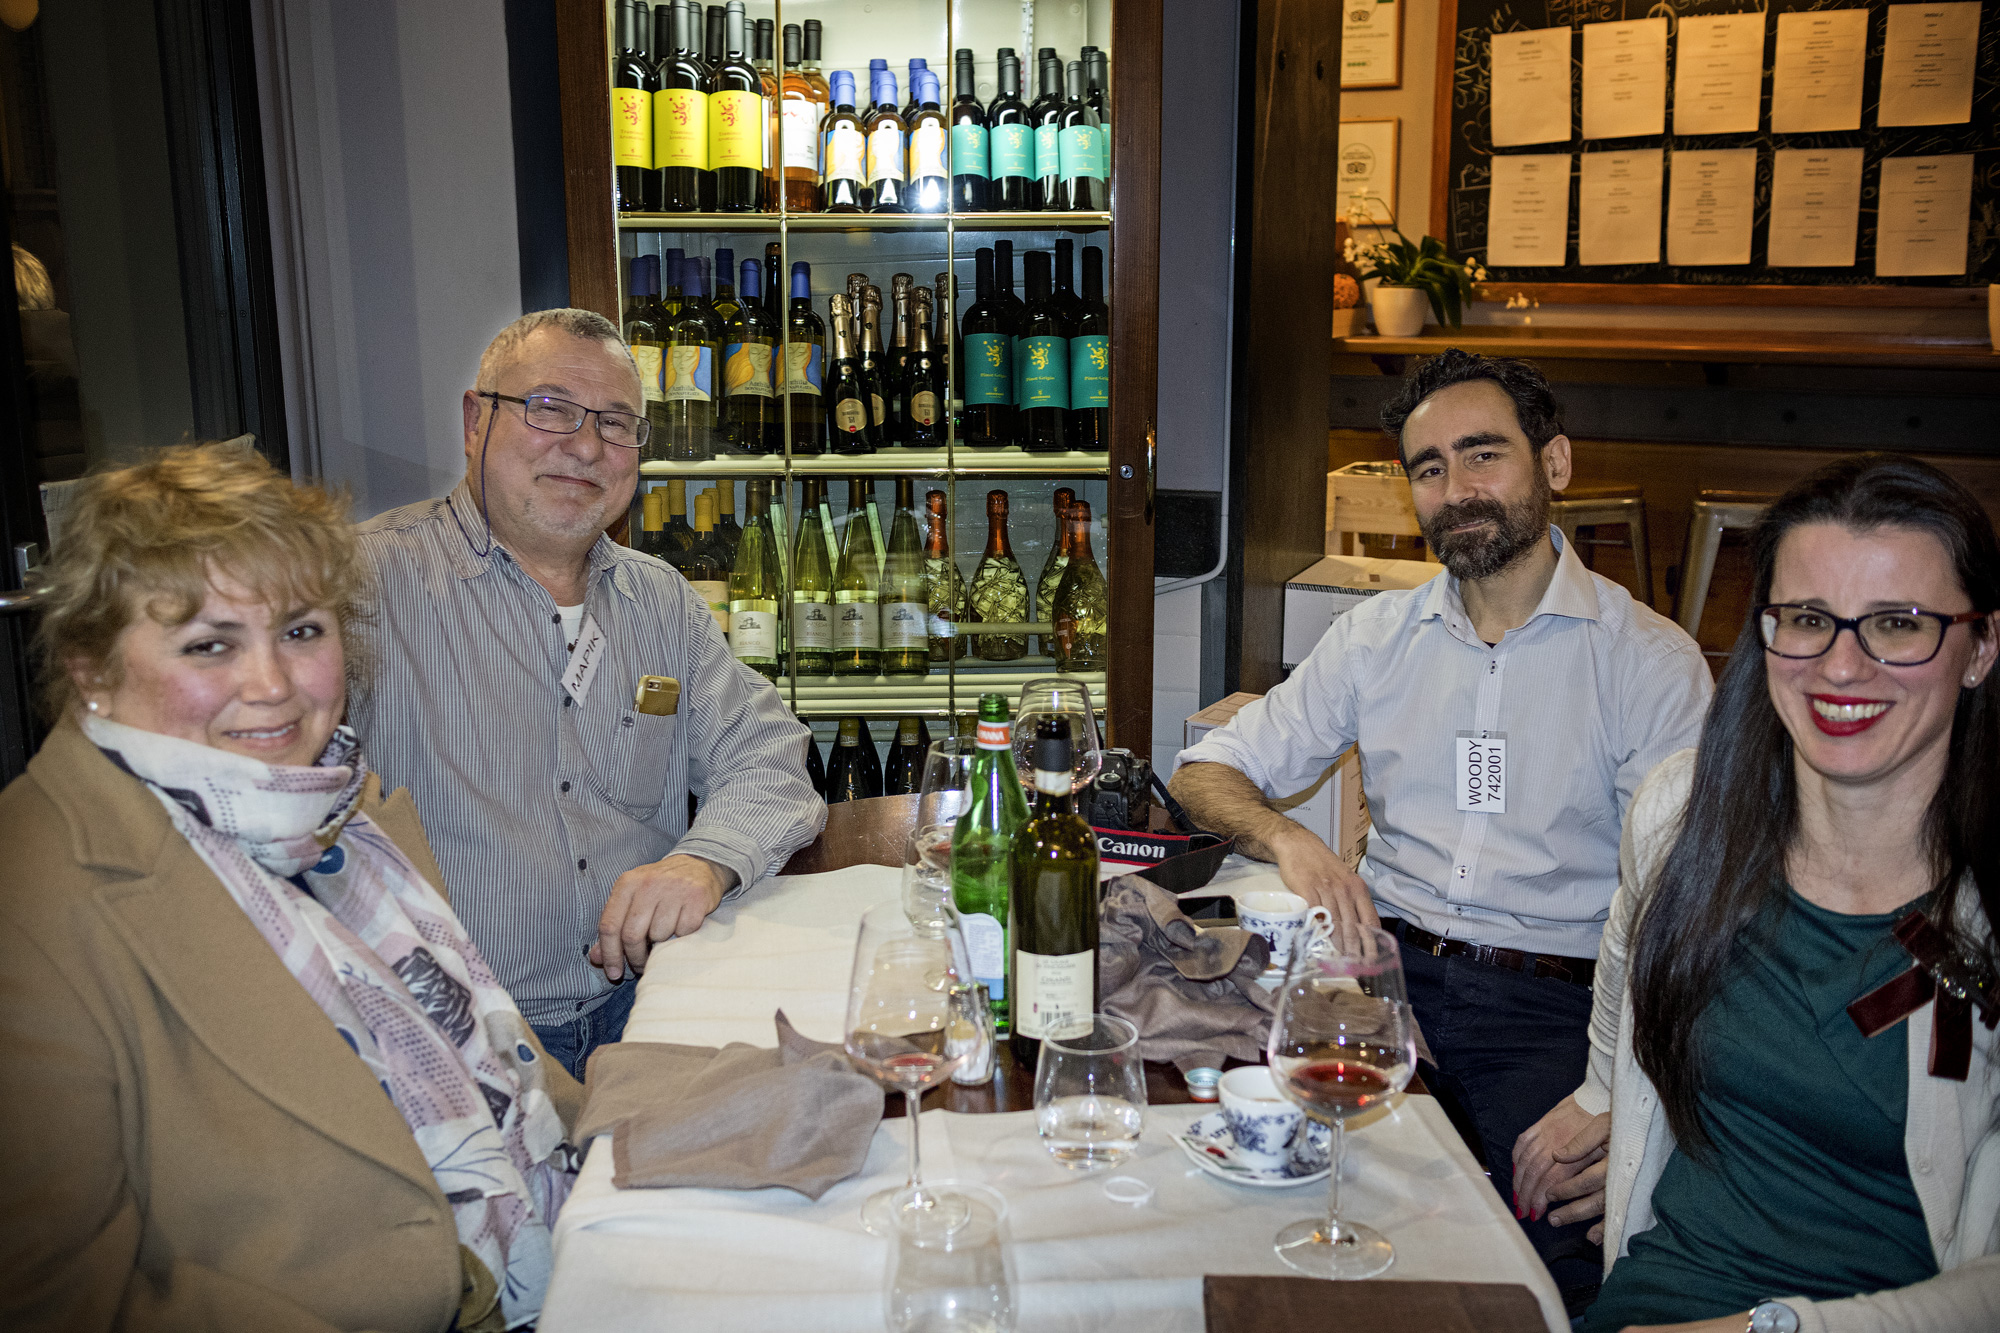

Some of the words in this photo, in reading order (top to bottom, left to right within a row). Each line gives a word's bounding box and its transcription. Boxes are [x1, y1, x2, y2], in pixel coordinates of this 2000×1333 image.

[1468, 739, 1482, 806] WOODY
[1487, 747, 1502, 802] 742001
[1097, 837, 1166, 859] Canon
